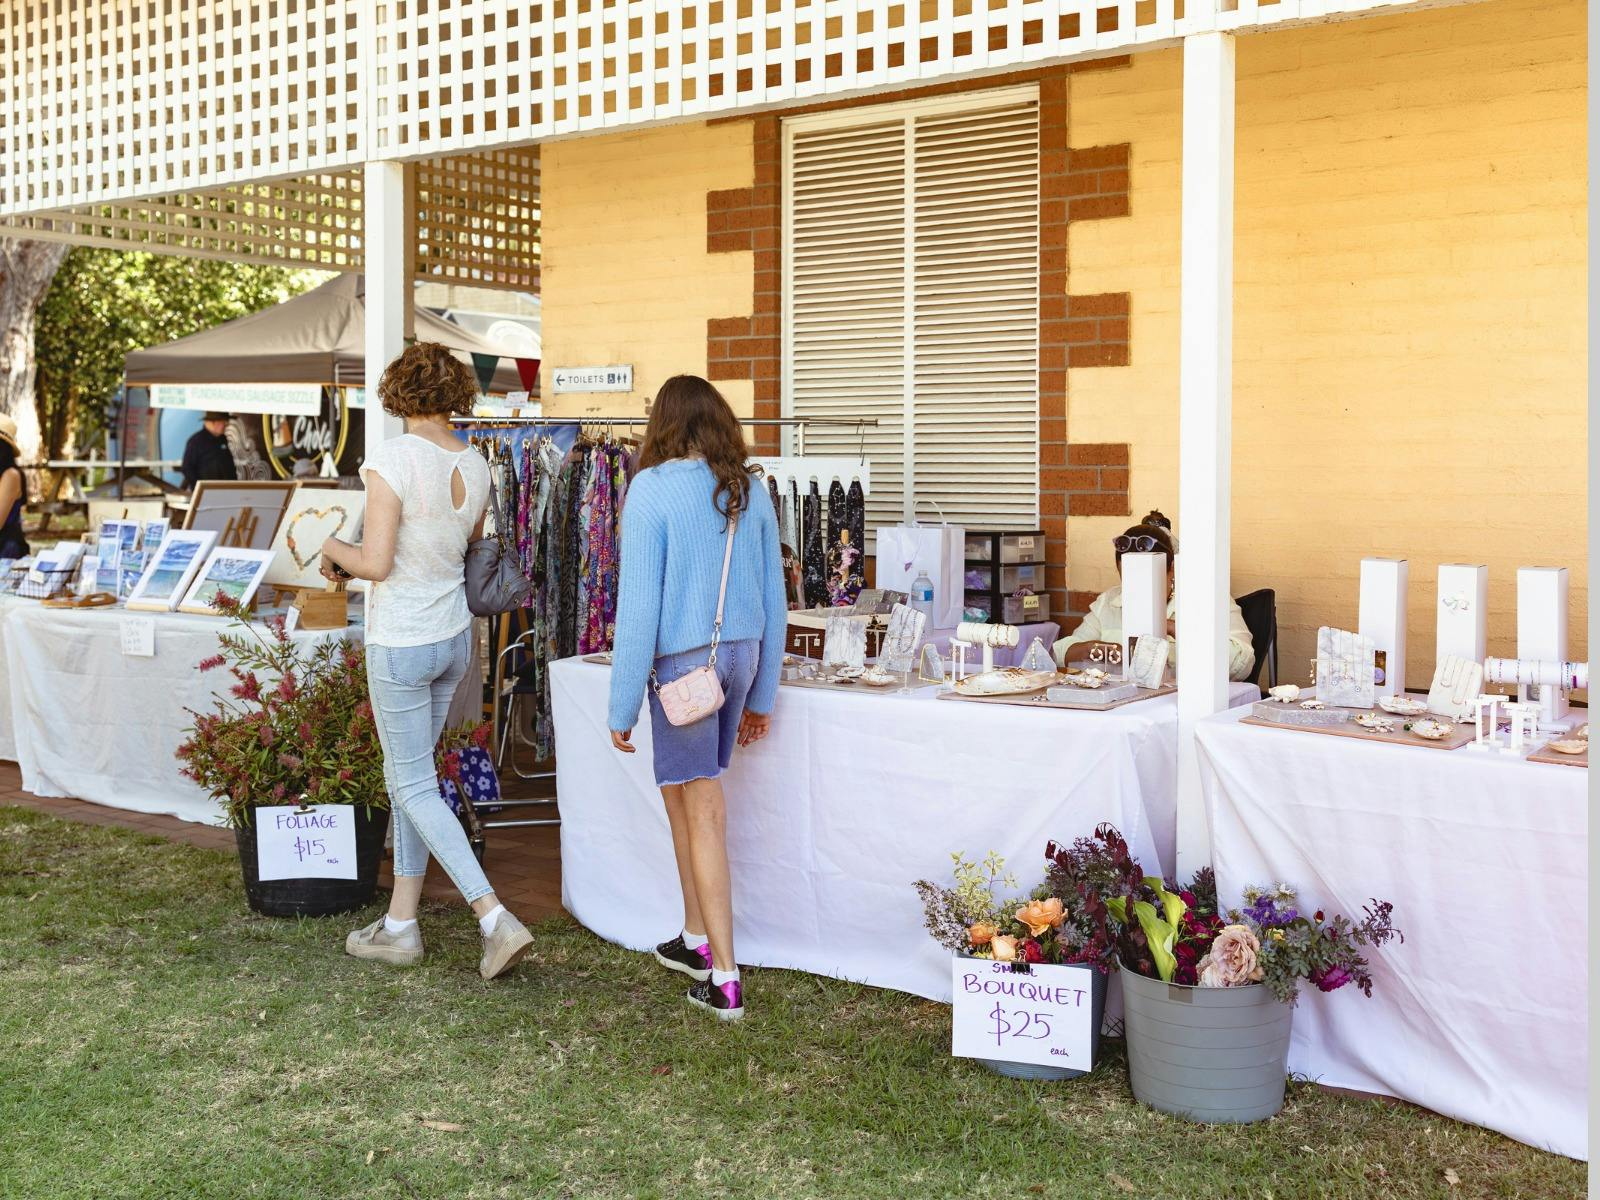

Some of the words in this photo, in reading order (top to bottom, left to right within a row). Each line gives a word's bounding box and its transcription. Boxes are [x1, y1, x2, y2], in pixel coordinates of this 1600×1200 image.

[568, 375, 604, 384] TOILETS
[247, 389, 285, 403] SAUSAGE
[287, 391, 315, 404] SIZZLE
[276, 814, 338, 829] FOLIAGE
[294, 836, 325, 862] $15
[992, 962, 1038, 977] SML
[963, 973, 1087, 1007] BOUQUET
[987, 1001, 1054, 1046] $25
[1050, 1048, 1069, 1057] each
